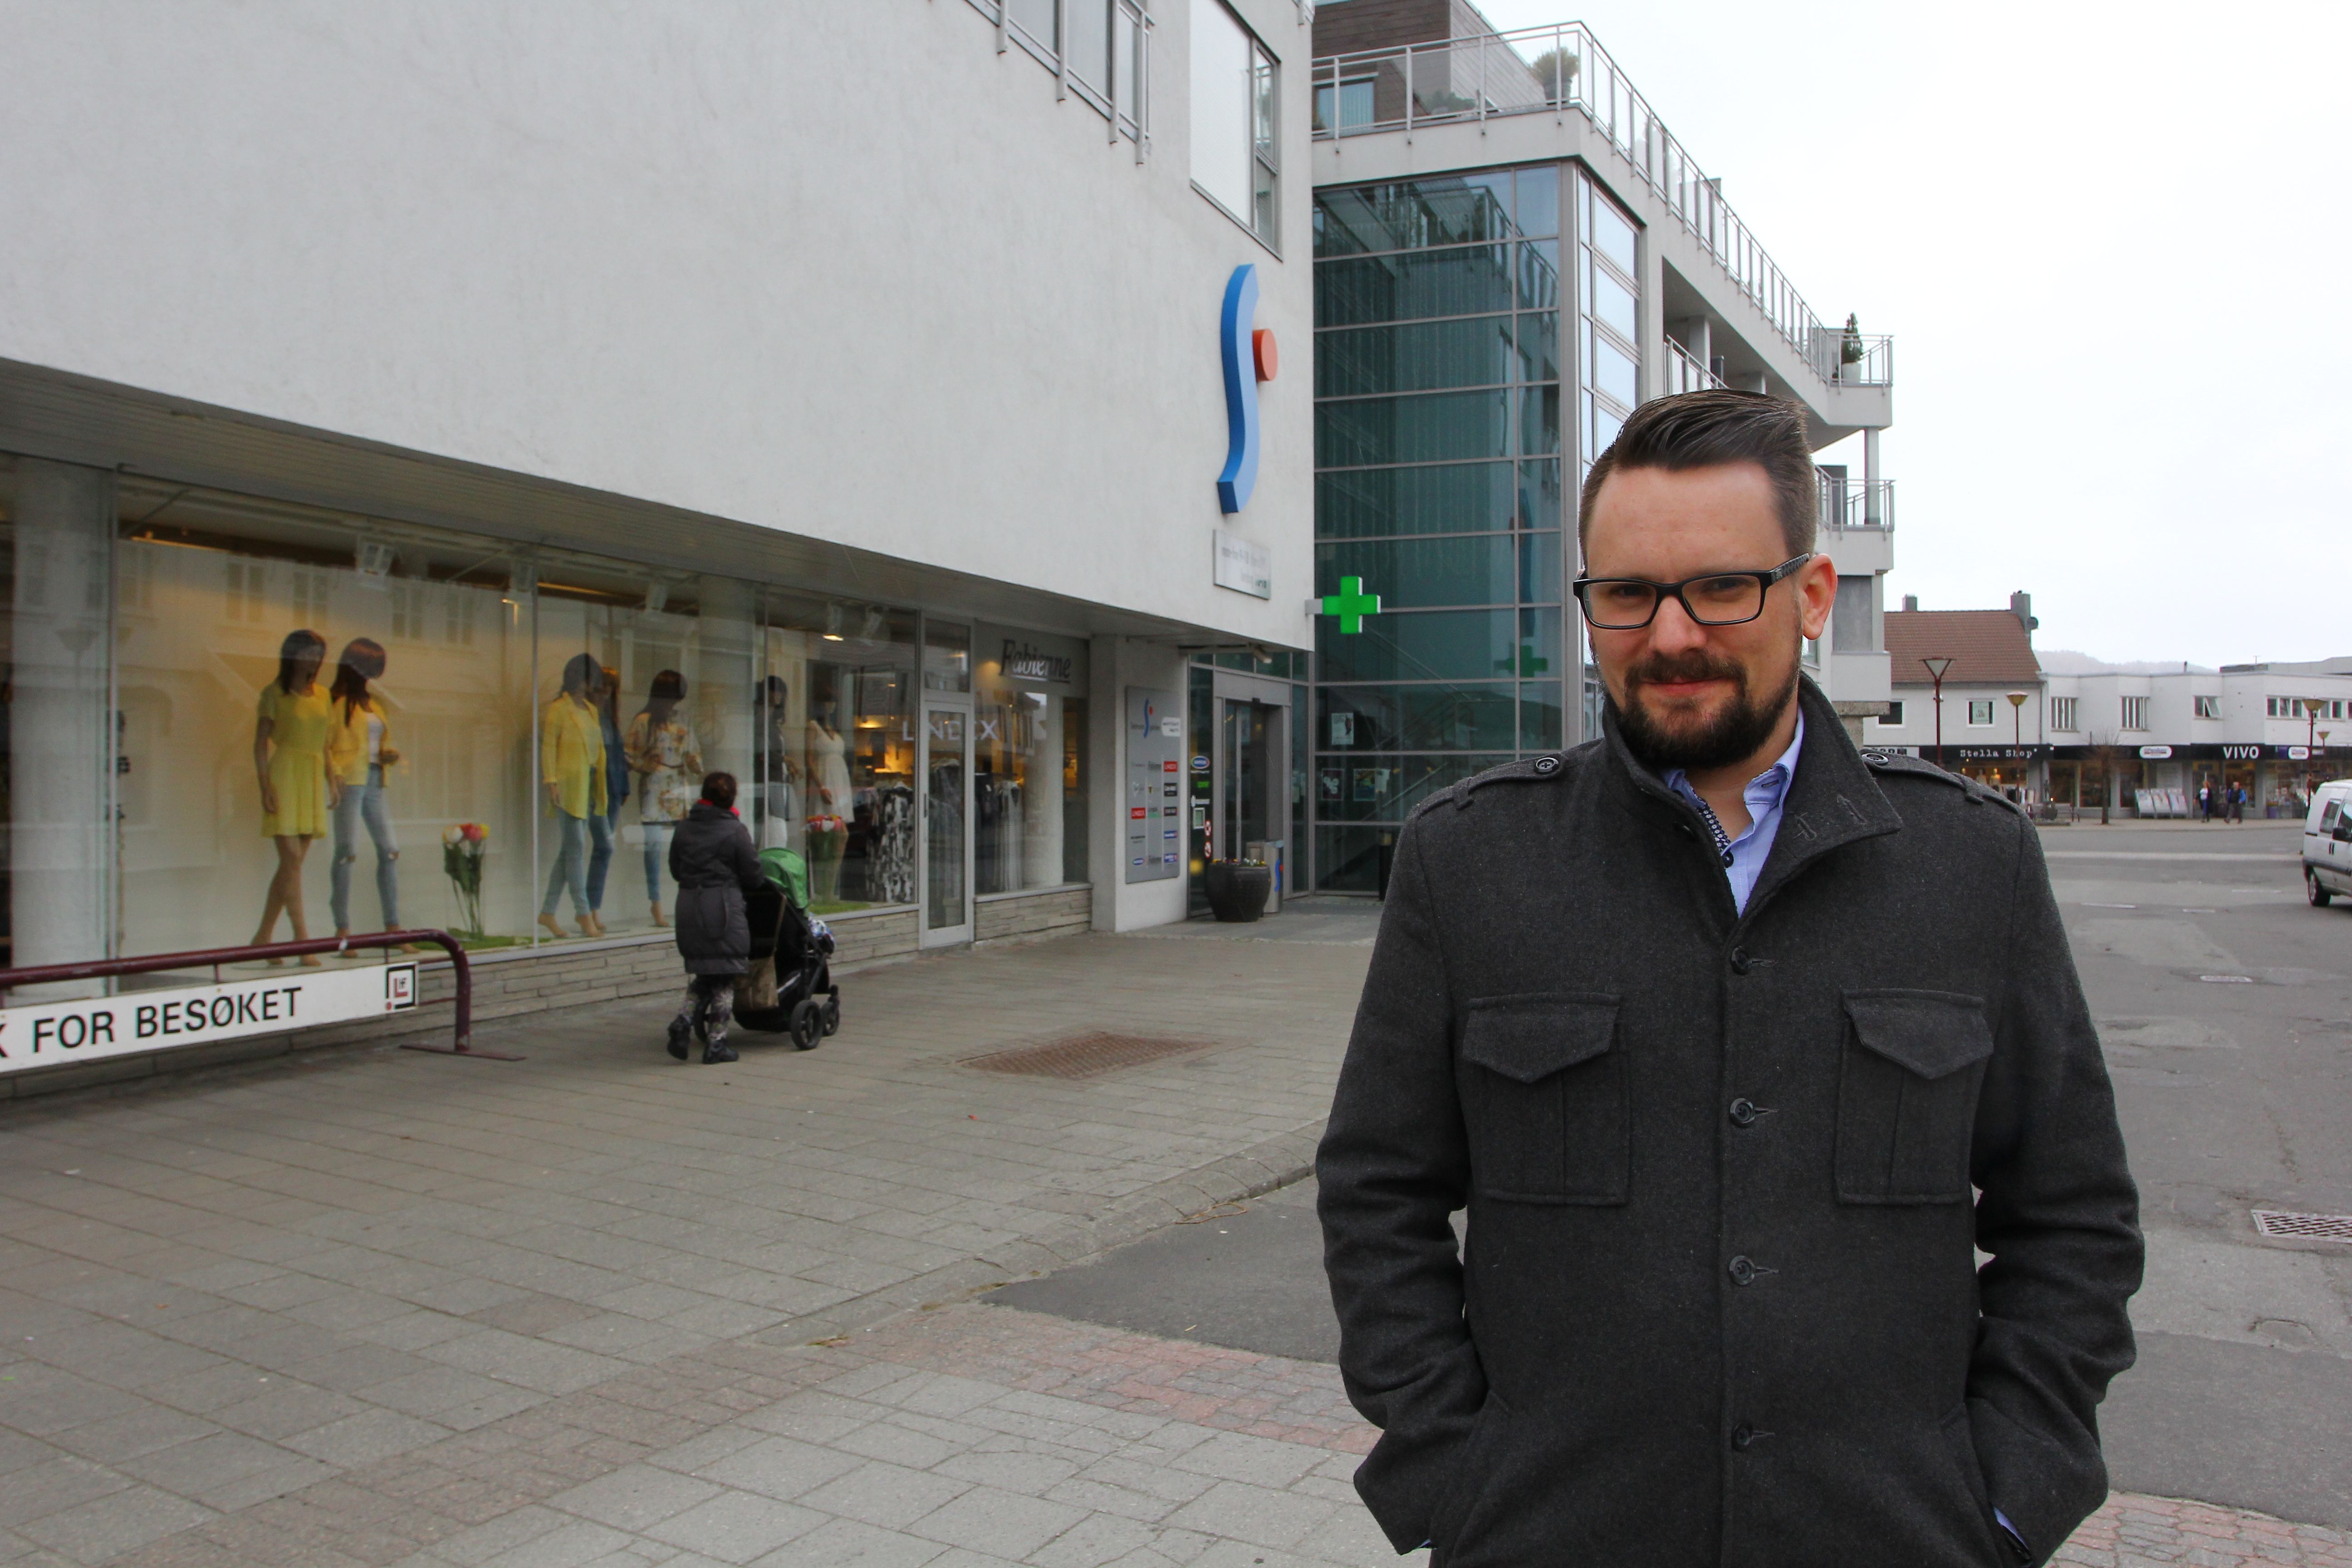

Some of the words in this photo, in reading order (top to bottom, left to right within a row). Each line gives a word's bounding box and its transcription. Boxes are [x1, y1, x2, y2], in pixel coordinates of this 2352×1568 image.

[1000, 638, 1071, 679] Fabienne
[1960, 749, 1999, 758] Stella
[2006, 749, 2033, 759] Shop
[2223, 745, 2260, 760] VIVO
[33, 1011, 115, 1054] FOR
[137, 986, 302, 1039] BESØKET
